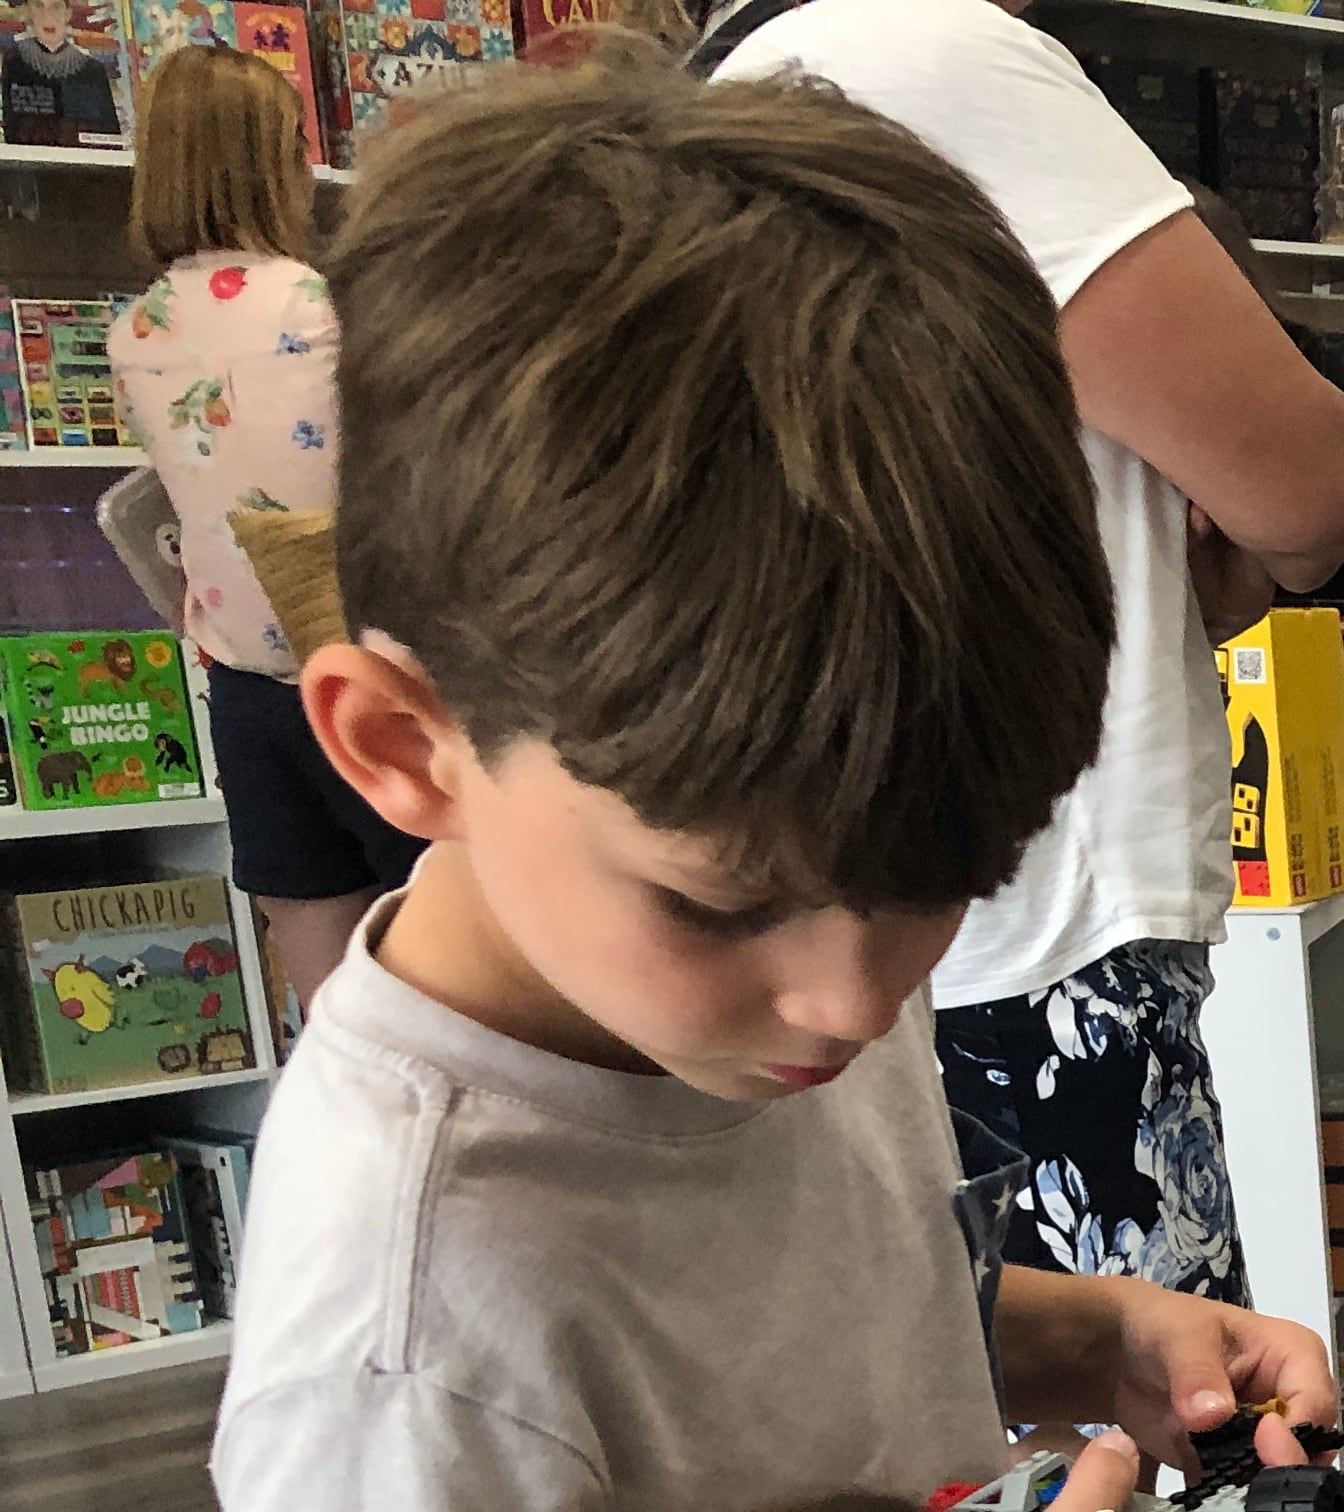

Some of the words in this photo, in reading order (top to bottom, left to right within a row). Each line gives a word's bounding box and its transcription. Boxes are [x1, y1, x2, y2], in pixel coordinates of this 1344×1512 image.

[61, 702, 151, 724] JUNGLE
[70, 724, 149, 746] BINGO
[53, 889, 196, 932] CHICKAPIG
